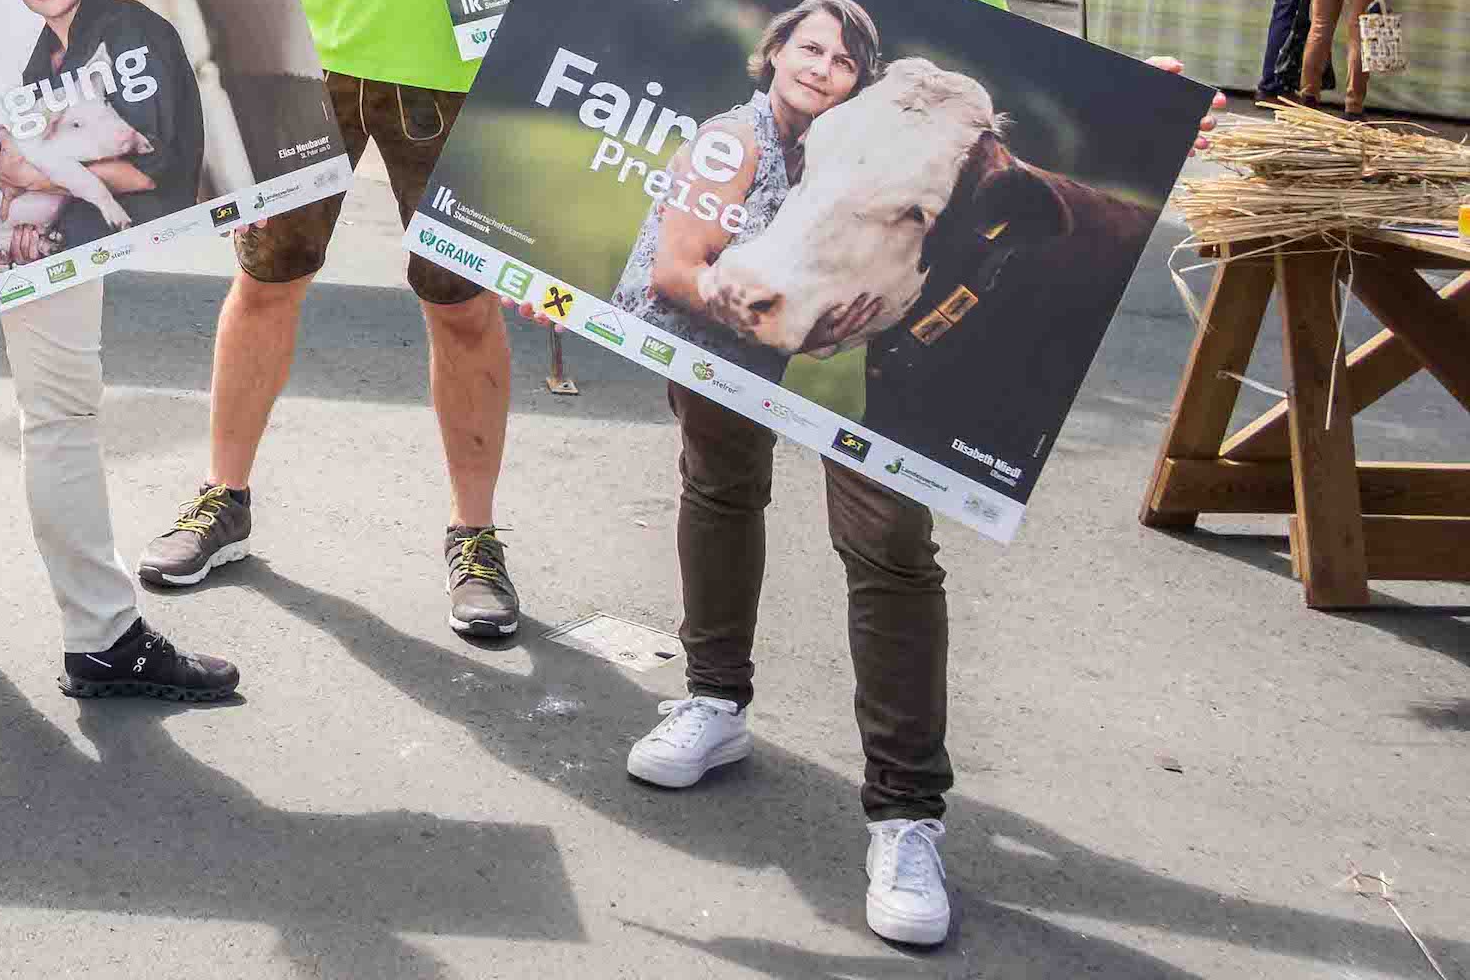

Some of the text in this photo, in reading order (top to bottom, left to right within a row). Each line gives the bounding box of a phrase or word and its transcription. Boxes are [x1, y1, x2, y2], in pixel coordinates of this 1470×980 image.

[535, 47, 747, 183] Faire
[278, 135, 330, 159] Elisa Neubauer
[431, 185, 458, 217] lk
[589, 137, 750, 236] Preise
[453, 210, 492, 234] Steiermark
[456, 201, 536, 245] Landwirtschaftskammer
[435, 238, 487, 273] GRAWE
[951, 438, 994, 467] Elisabeth
[994, 458, 1023, 479] Miedl
